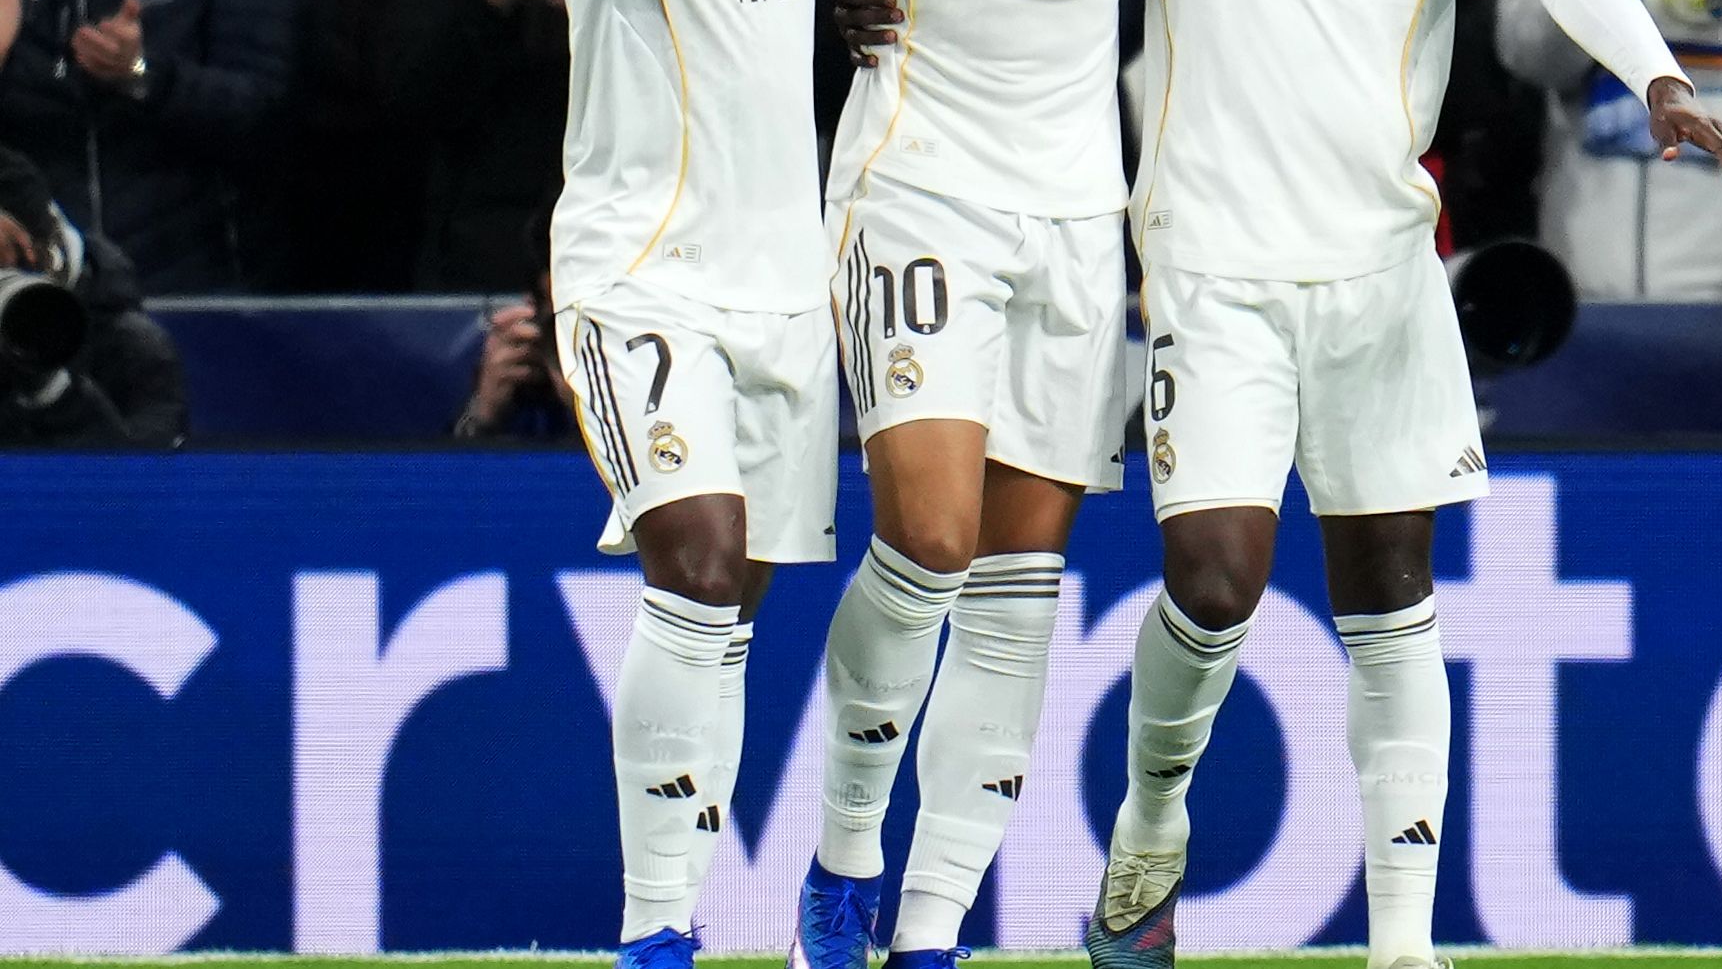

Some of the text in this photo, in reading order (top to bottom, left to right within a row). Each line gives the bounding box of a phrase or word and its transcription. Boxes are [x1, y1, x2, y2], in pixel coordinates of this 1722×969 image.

[873, 257, 949, 340] 10
[626, 332, 673, 416] 7
[1151, 333, 1175, 422] 6
